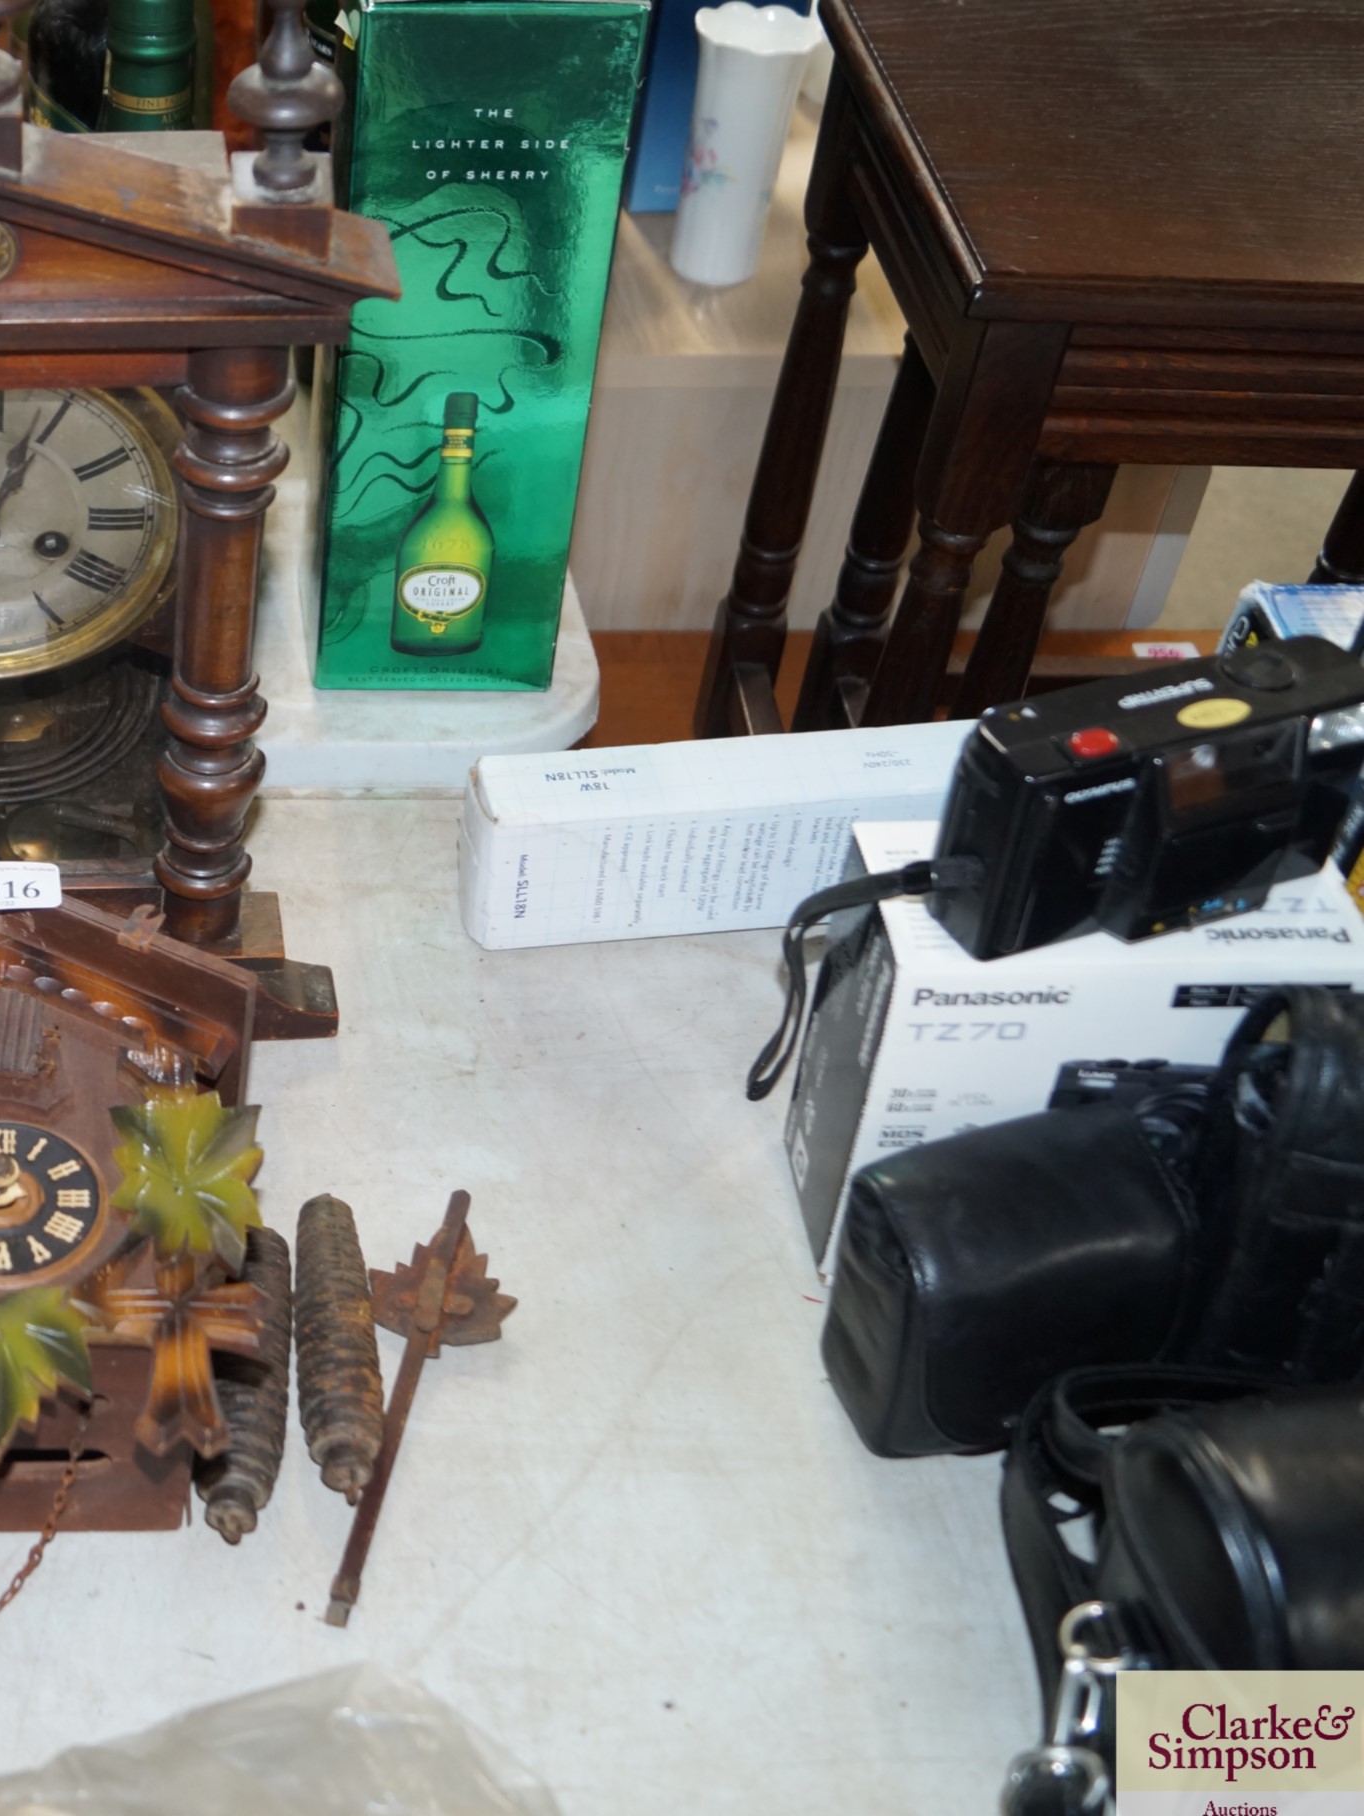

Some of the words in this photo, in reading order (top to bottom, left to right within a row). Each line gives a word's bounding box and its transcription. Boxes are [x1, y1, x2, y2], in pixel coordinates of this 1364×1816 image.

[474, 109, 514, 118] THE
[412, 140, 505, 149] LIGHTER
[520, 140, 570, 149] SIDE
[426, 170, 451, 180] OF
[466, 170, 549, 180] SHERRY
[428, 575, 456, 587] Croft
[413, 587, 469, 597] ORIGINAL
[369, 666, 421, 675] CROFT
[429, 665, 504, 675] ORIGINAL
[545, 770, 598, 782] SLL18N
[580, 782, 610, 792] 18W
[598, 834, 612, 878] Manufactured
[514, 880, 529, 919] SLL18N
[1205, 926, 1351, 945] Panasonic
[912, 985, 1070, 1007] Panasonic
[906, 1021, 1027, 1042] TZ70
